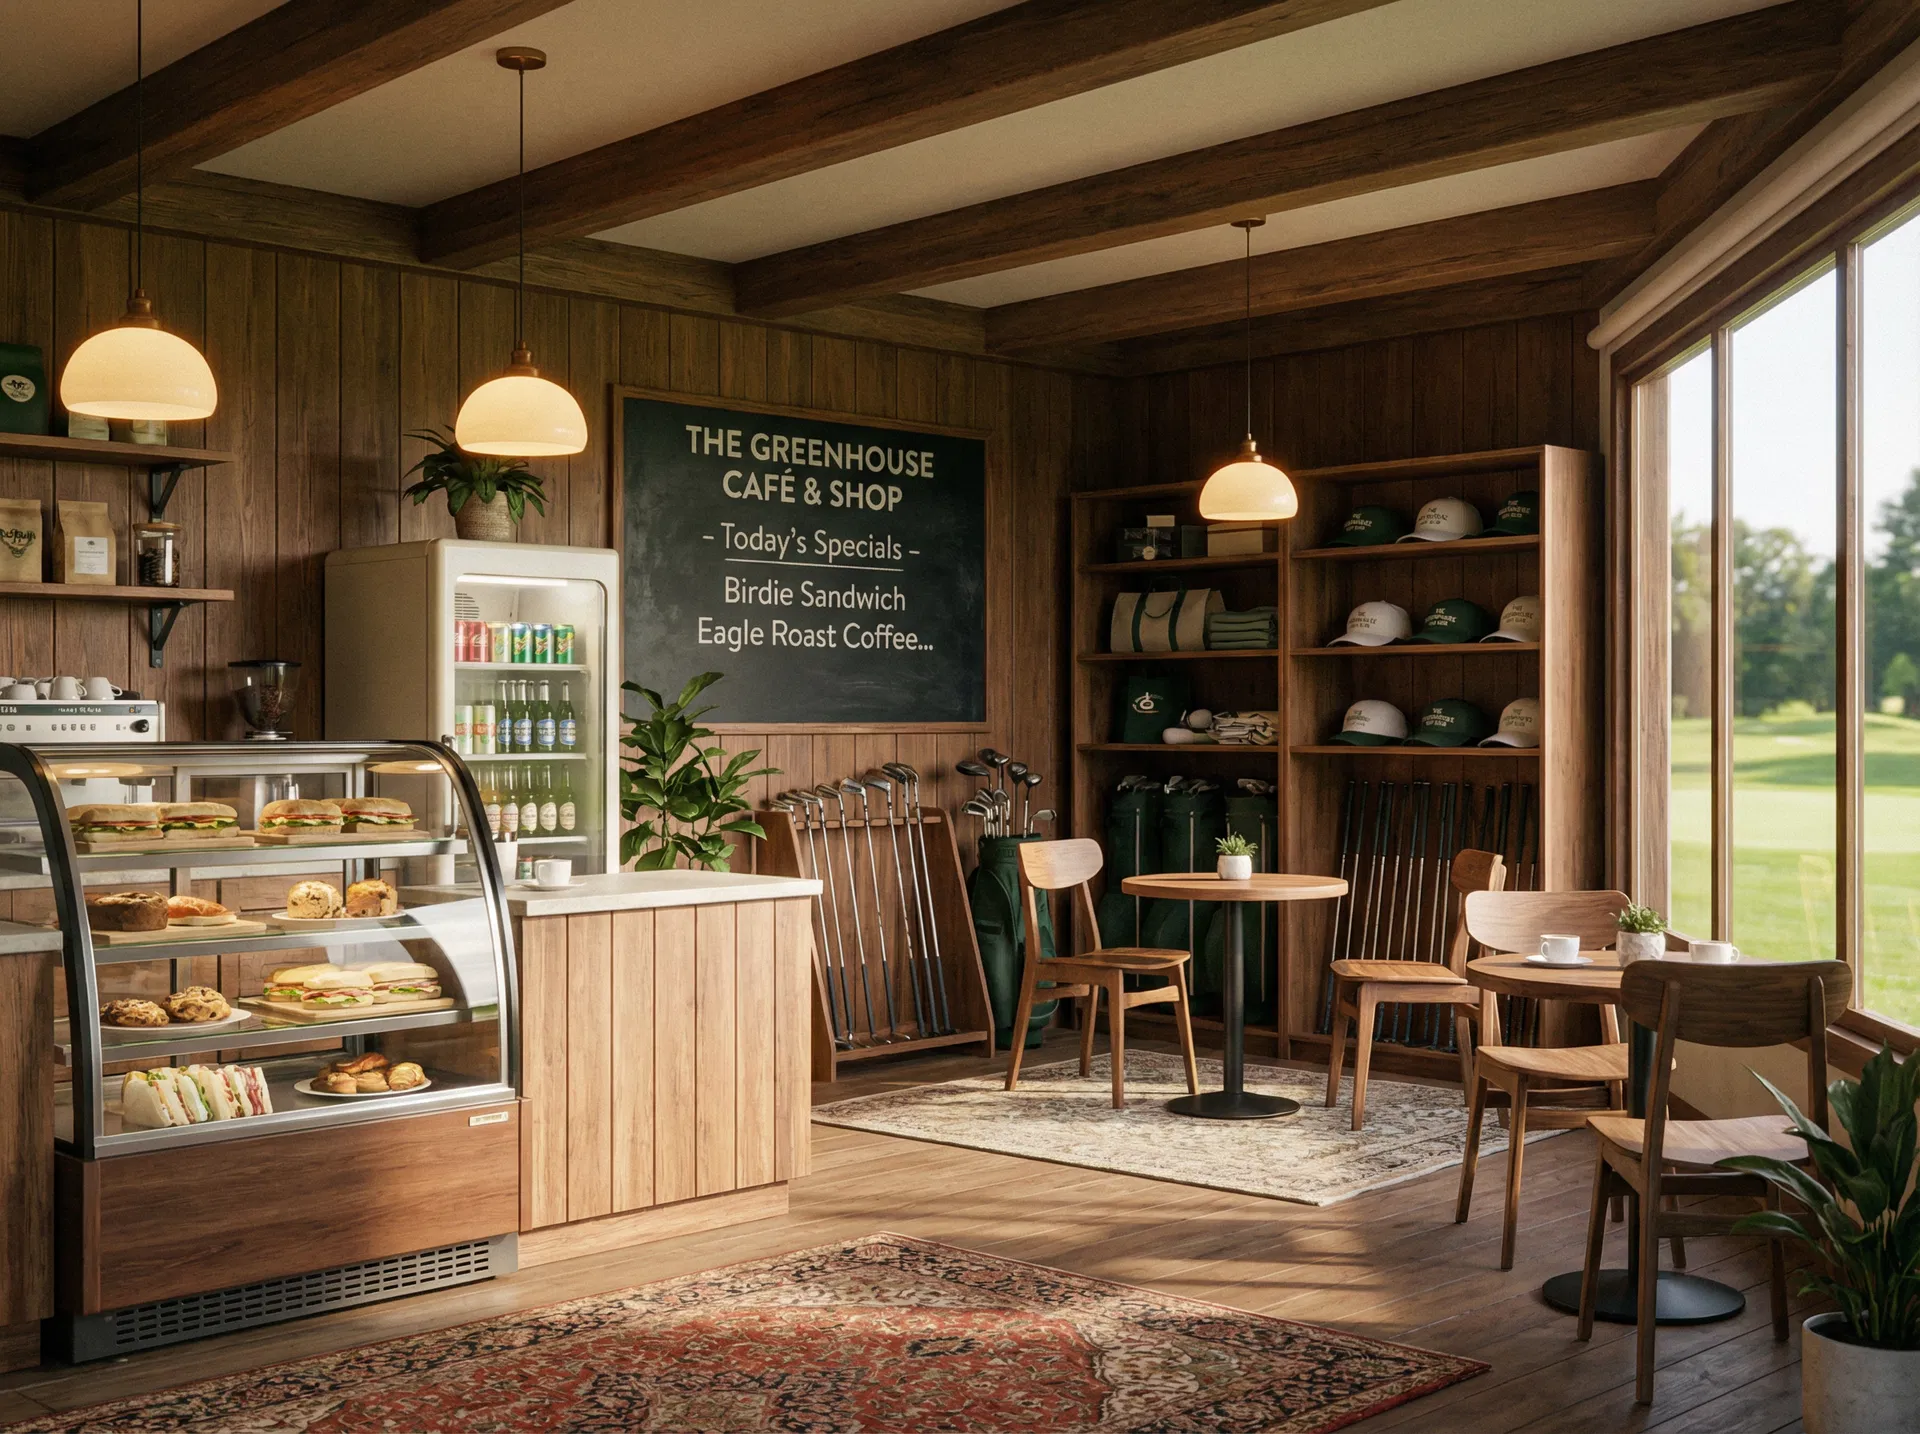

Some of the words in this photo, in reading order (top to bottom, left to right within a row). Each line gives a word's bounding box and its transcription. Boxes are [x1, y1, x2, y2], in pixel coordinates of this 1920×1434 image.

[685, 424, 742, 458] THE
[750, 432, 934, 479] GREENHOUSE
[722, 467, 796, 504] CAFÉ
[803, 477, 822, 506] &
[829, 479, 904, 512] SHOP
[720, 522, 807, 559] Today’s
[814, 529, 902, 564] Specials
[724, 575, 794, 606] Birdie
[800, 580, 906, 611] Sandwich
[697, 616, 765, 653] Eagle
[771, 619, 837, 648] Roast
[842, 622, 934, 651] Coffee...
